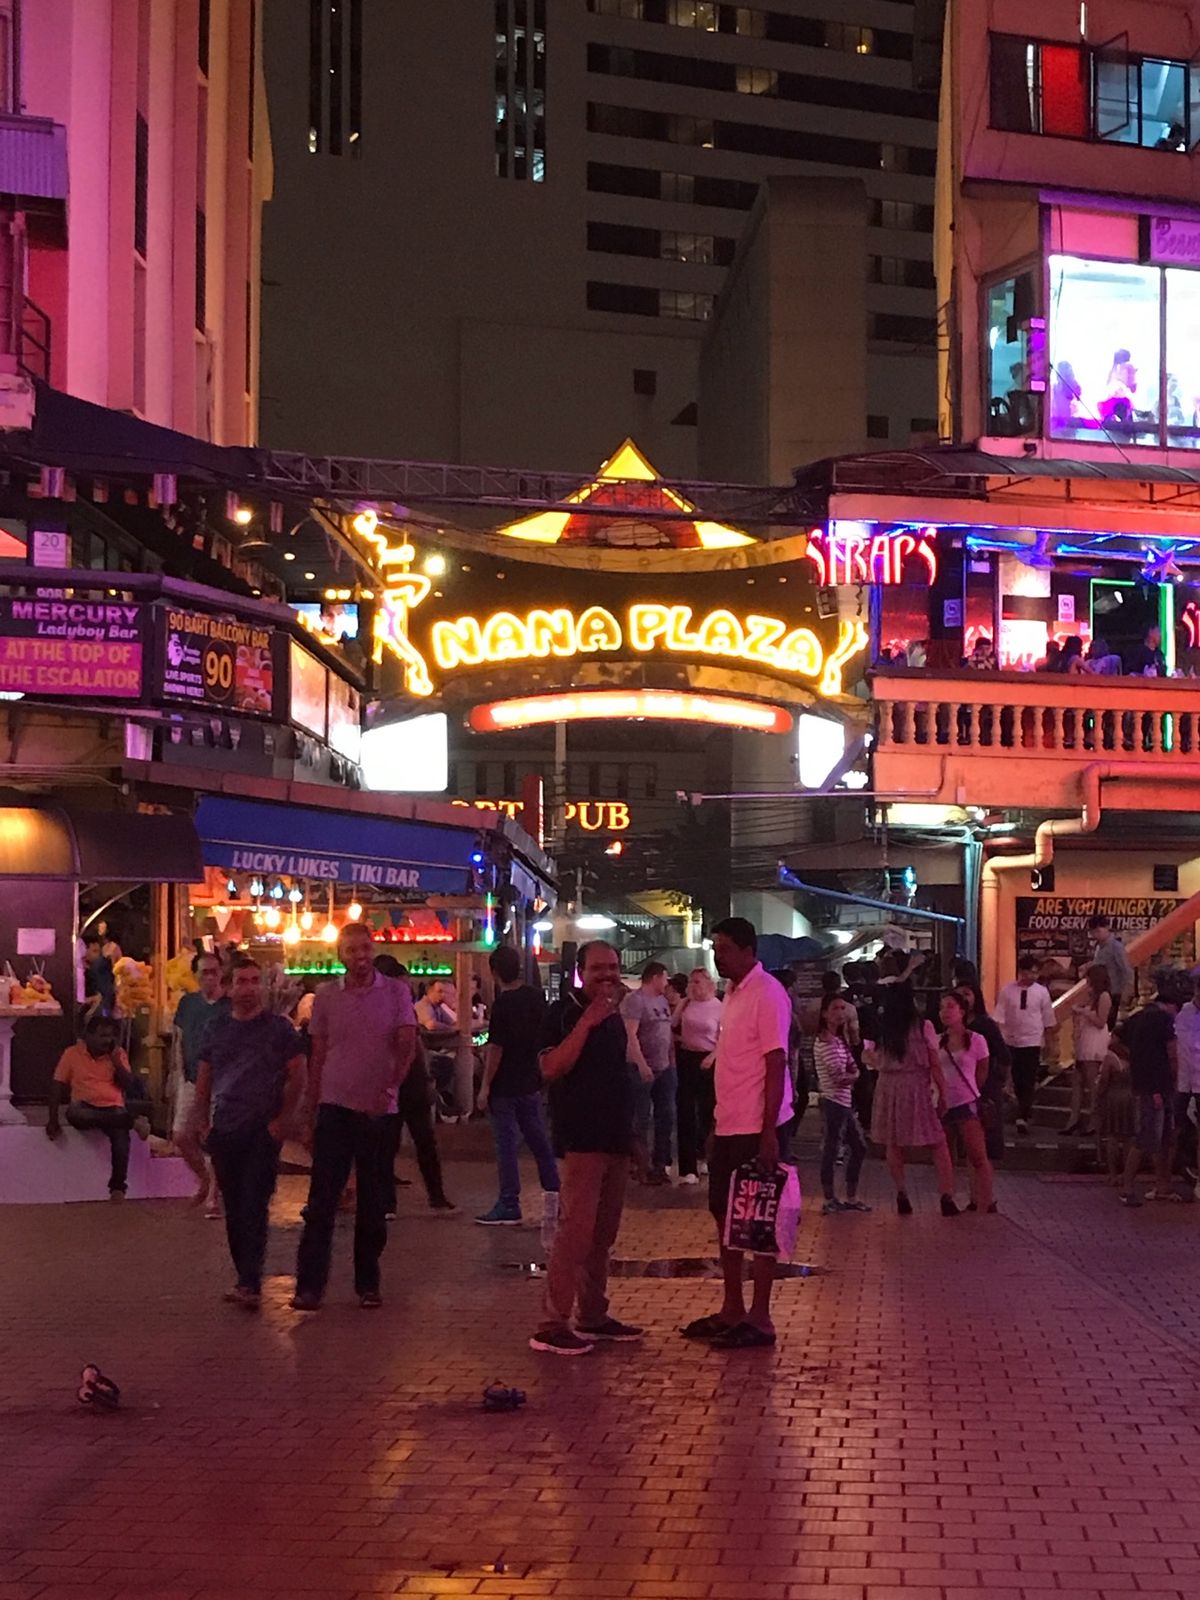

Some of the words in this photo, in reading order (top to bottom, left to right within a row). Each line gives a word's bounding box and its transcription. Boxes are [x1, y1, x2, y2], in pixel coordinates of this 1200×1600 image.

[41, 534, 60, 548] 20
[806, 528, 937, 587] STRAPS
[12, 601, 139, 624] MERCURY
[38, 622, 105, 640] Ladyboy
[109, 624, 139, 639] Bar
[169, 612, 184, 631] 90
[184, 616, 209, 636] BAHT
[210, 621, 251, 645] BALCONY
[252, 630, 270, 649] BAR
[432, 606, 623, 669] NANA
[629, 604, 823, 677] PLAZA
[6, 640, 27, 660] AT
[31, 642, 66, 662] THE
[69, 643, 105, 664] TOP
[108, 646, 133, 665] OF
[0, 665, 33, 685] THE
[36, 667, 140, 690] ESCALATOR
[206, 651, 233, 688] 90
[232, 850, 284, 872] LUCKY
[288, 856, 339, 879] LUKES
[351, 863, 382, 883] TIKI
[386, 867, 420, 888] BAR
[1034, 898, 1063, 915] ARE
[1067, 898, 1096, 915] YOU
[1097, 899, 1158, 916] HUNGRY
[1028, 916, 1059, 929] FOOD
[1116, 916, 1148, 930] THESE
